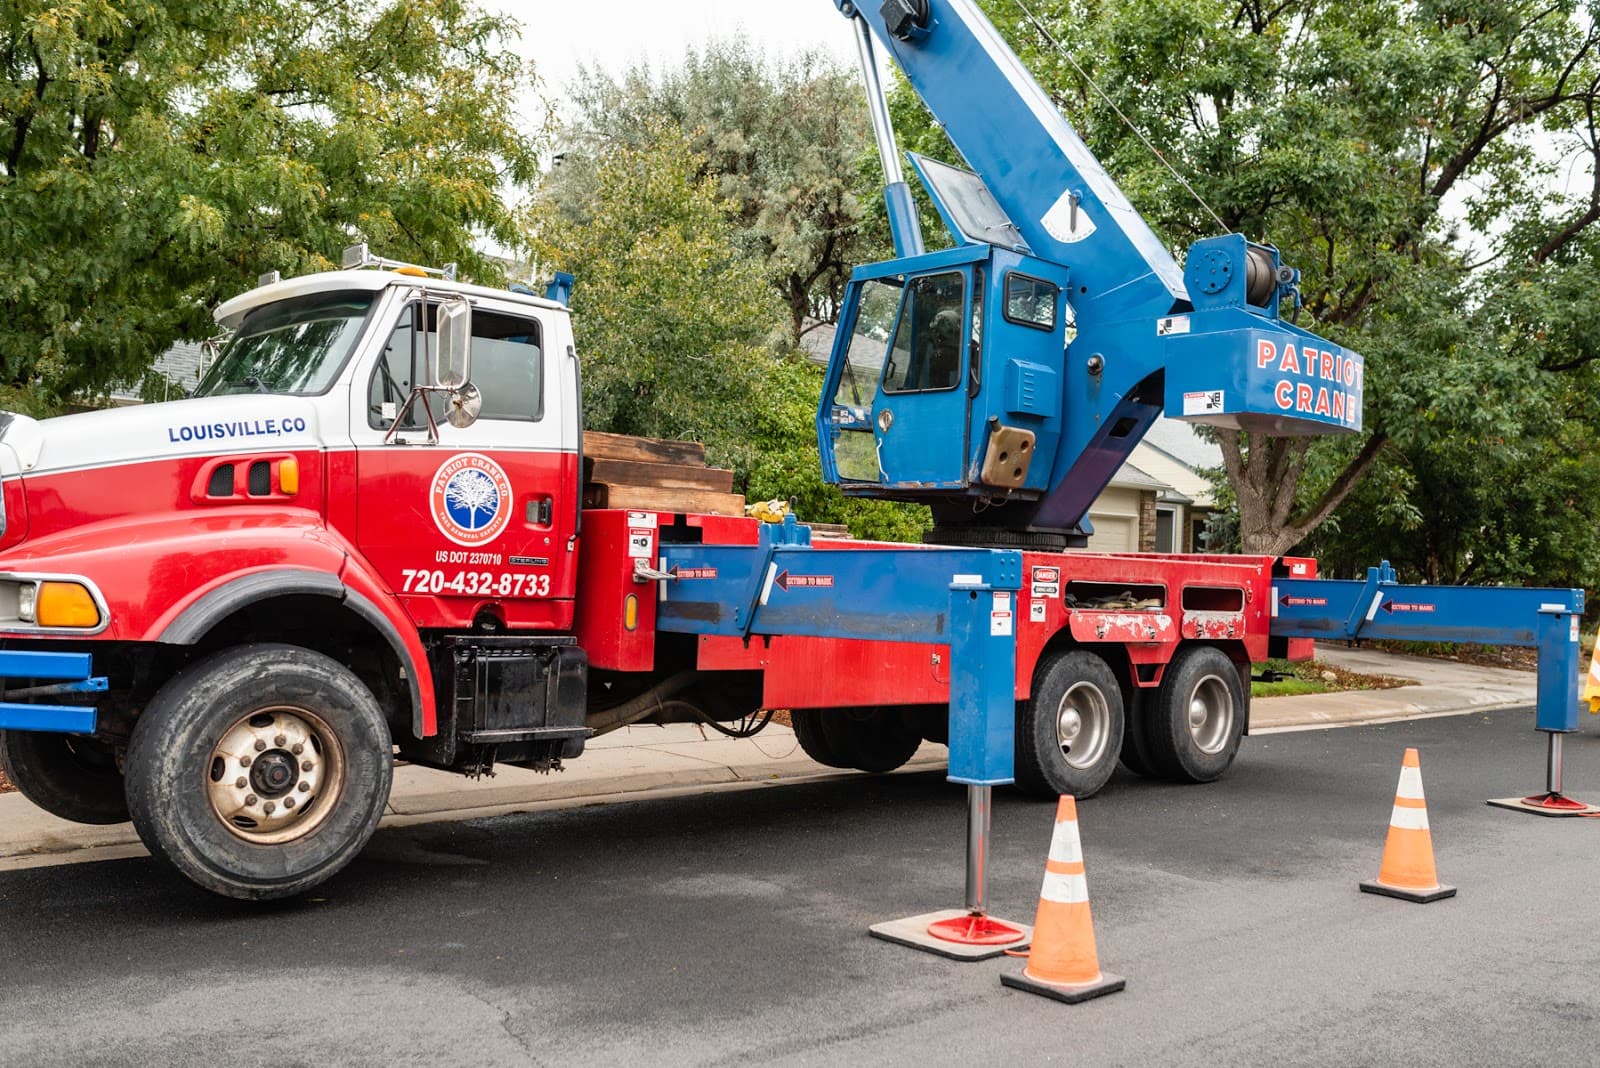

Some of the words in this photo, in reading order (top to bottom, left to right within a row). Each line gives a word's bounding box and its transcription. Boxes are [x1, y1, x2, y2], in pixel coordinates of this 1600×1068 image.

[1257, 339, 1363, 390] PATRIOT
[1275, 379, 1356, 423] CRANE
[435, 458, 468, 494] PATRIOT
[471, 457, 502, 482] CRANE
[451, 526, 479, 539] REMOVAL
[480, 517, 503, 537] EXPERTS
[435, 550, 448, 562] US
[450, 551, 468, 563] DOT
[469, 552, 502, 565] 2370710
[401, 568, 550, 596] 720-432-8733
[786, 577, 807, 585] EXTEND
